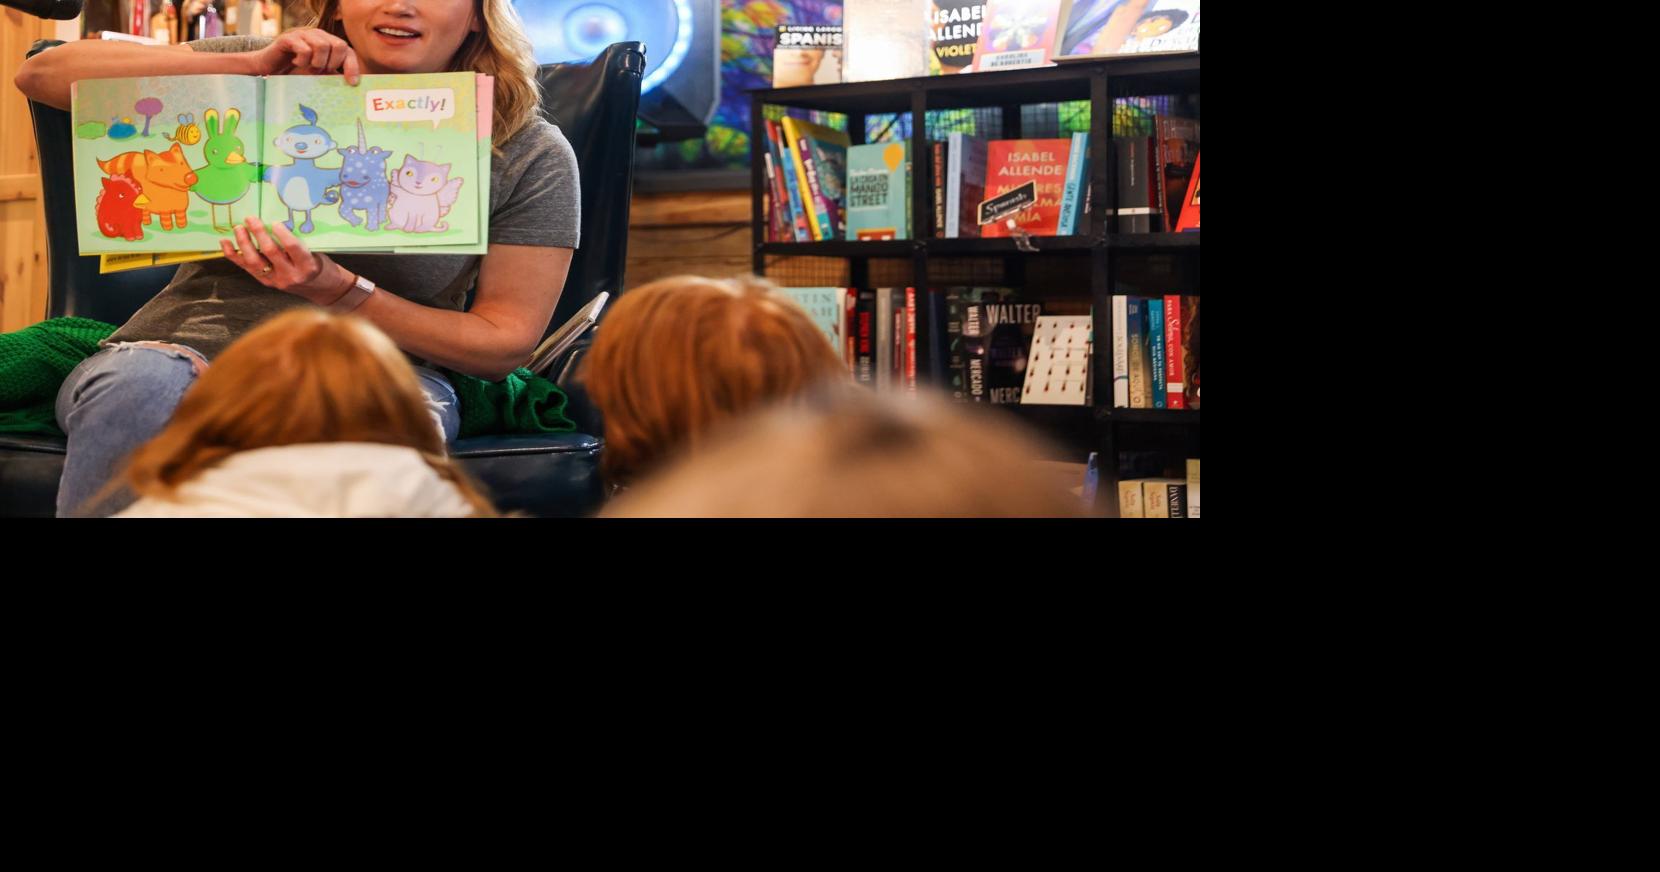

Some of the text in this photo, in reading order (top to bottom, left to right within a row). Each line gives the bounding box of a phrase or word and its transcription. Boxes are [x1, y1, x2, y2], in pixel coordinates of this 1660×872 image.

[779, 32, 842, 46] SPANIS
[936, 43, 977, 57] VIOLET
[372, 96, 446, 112] Exactly!
[1007, 151, 1056, 162] ISABEL
[998, 165, 1064, 176] ALLENDE
[851, 193, 888, 207] STREET
[986, 304, 1041, 324] WALTER
[967, 305, 983, 395] WALTER MERCADO
[990, 387, 1020, 404] MERC
